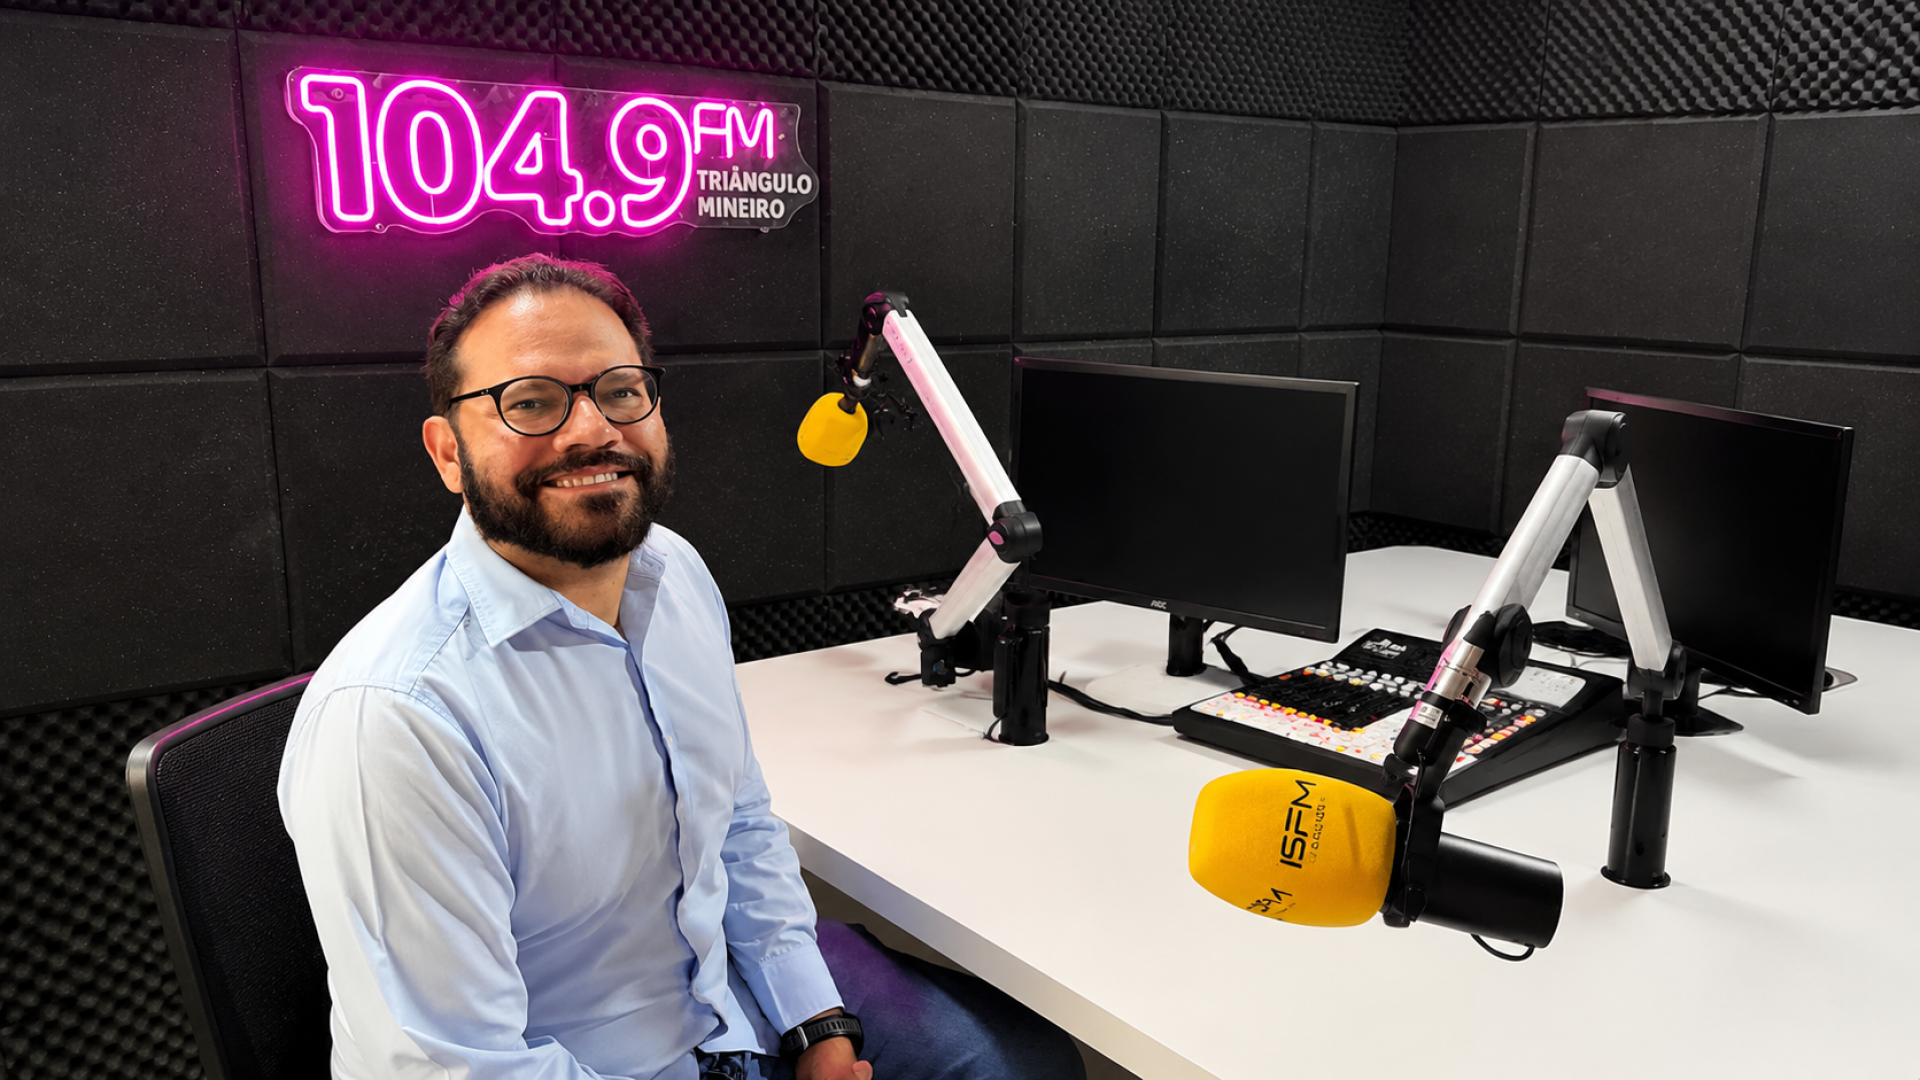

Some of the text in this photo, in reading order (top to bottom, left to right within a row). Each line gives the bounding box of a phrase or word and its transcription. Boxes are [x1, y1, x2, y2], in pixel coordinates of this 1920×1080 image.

[299, 74, 775, 227] 104.9 FM
[697, 195, 786, 220] MINEIRO
